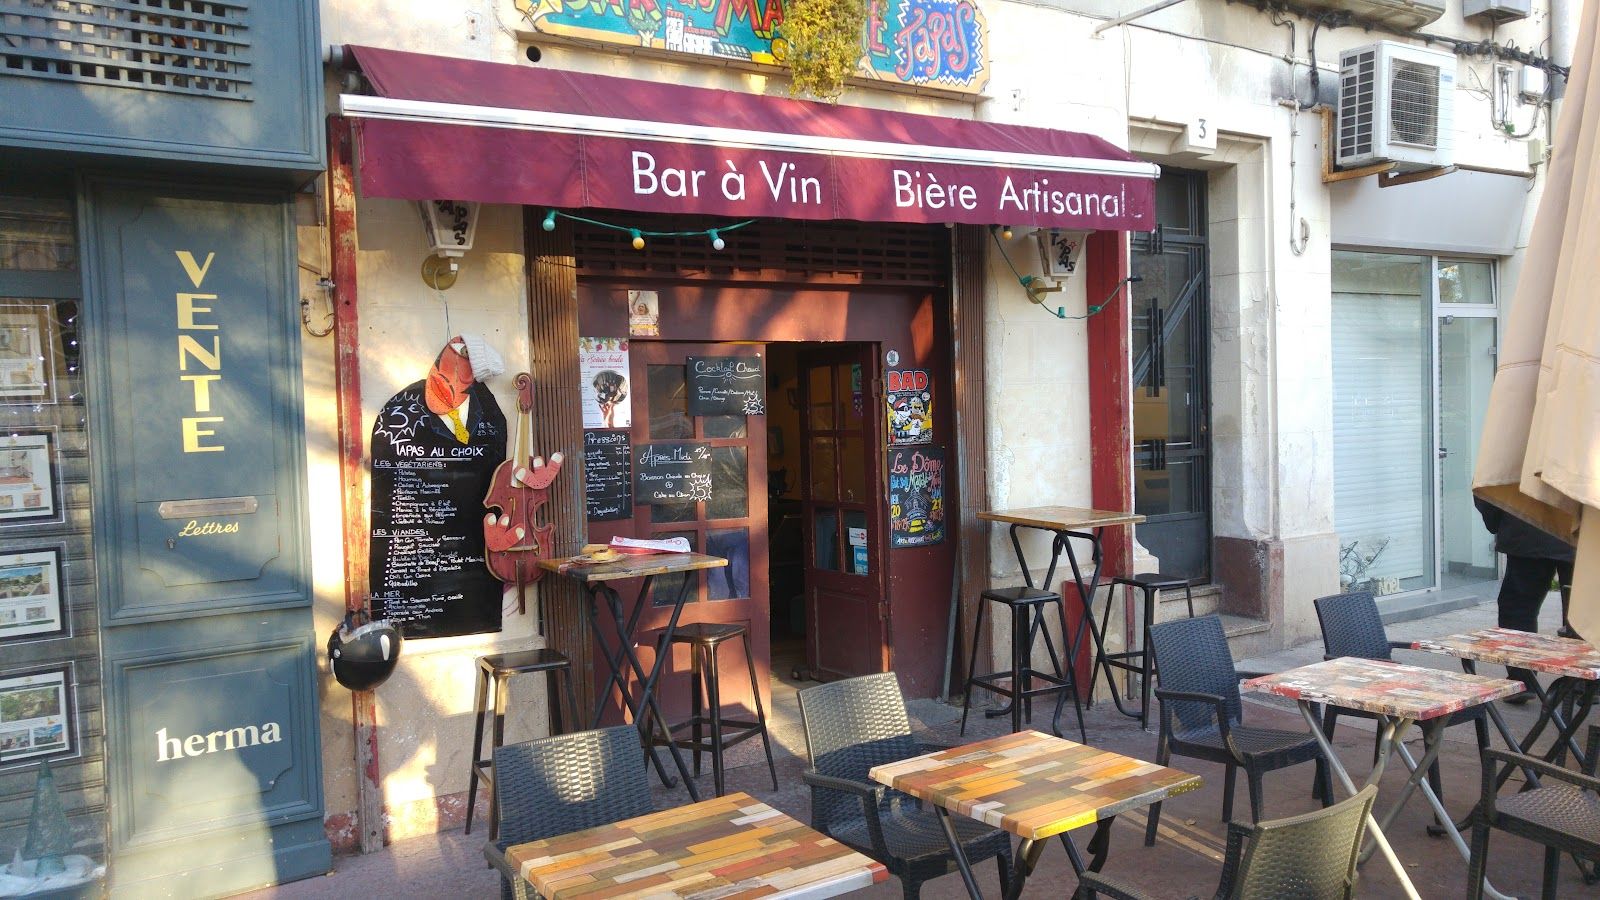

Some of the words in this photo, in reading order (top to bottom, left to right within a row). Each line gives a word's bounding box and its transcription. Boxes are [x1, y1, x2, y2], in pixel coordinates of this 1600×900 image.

[1198, 118, 1207, 140] 3
[631, 150, 706, 197] Bar
[721, 159, 746, 201] à
[759, 160, 822, 205] Vin
[893, 169, 978, 210] Bière
[434, 200, 469, 246] APAS
[175, 250, 225, 452] VENTE
[887, 370, 929, 393] BAD
[430, 447, 445, 457] AU
[178, 519, 240, 538] Lettres
[154, 720, 282, 763] herma
